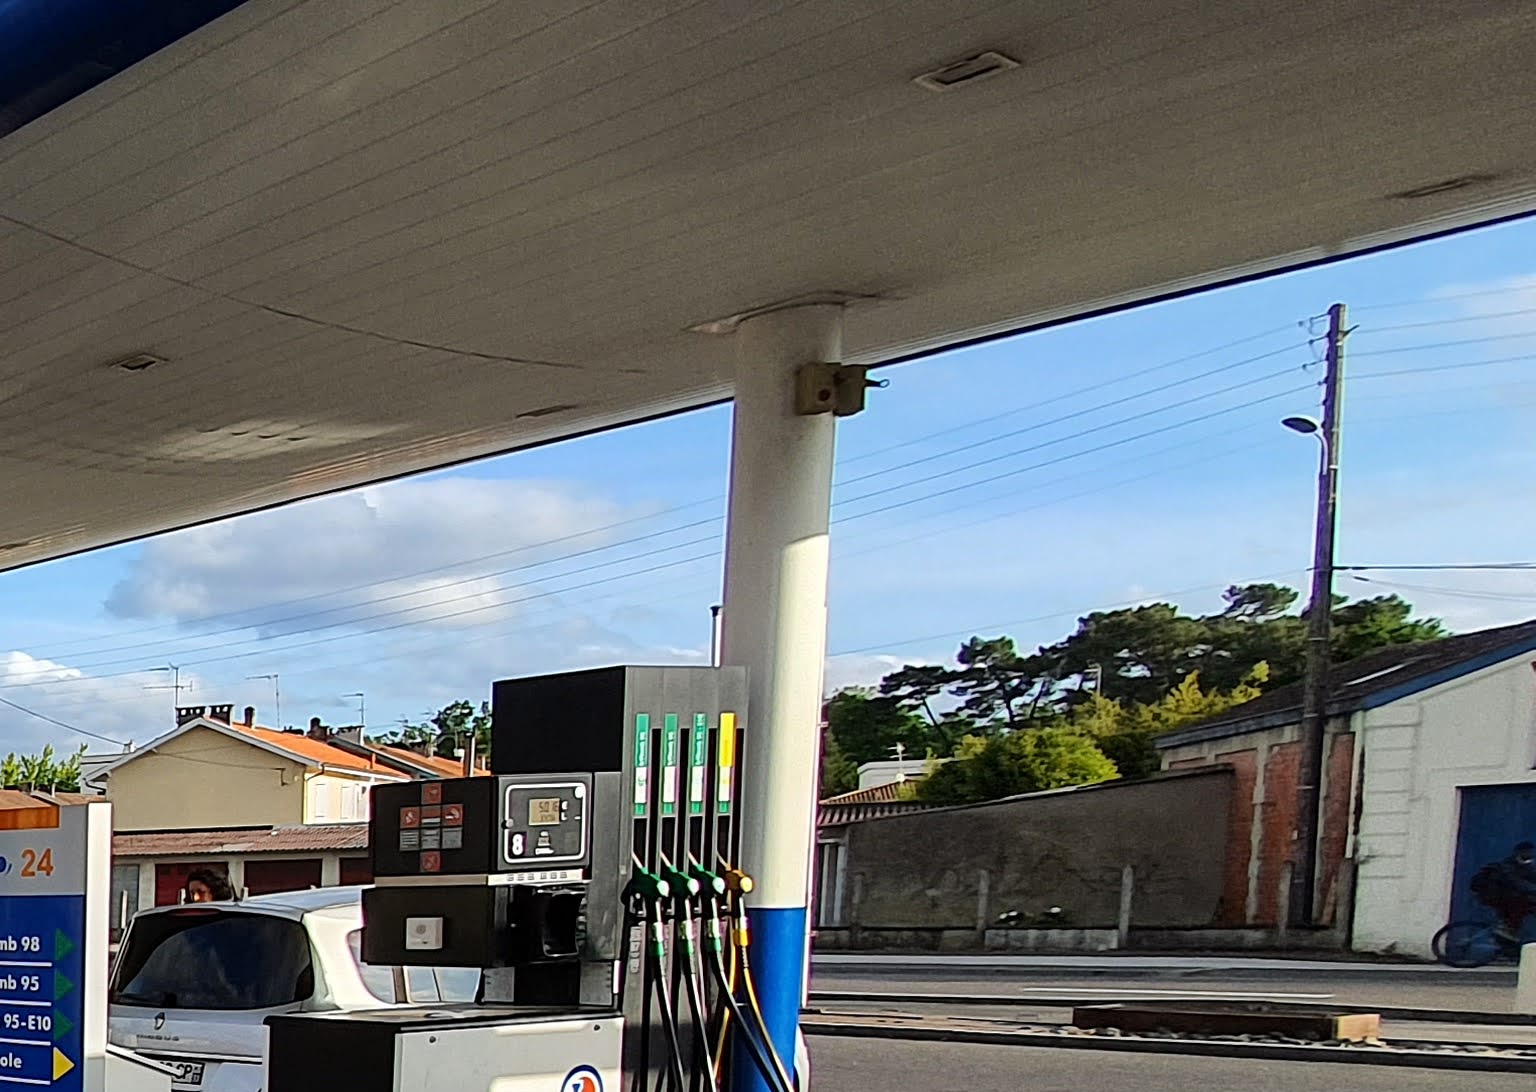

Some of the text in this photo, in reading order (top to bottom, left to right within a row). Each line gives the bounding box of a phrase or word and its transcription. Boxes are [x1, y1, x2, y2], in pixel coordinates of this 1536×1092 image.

[511, 833, 524, 856] 8
[20, 848, 55, 877] 24
[21, 936, 40, 952] 98
[20, 975, 40, 991] 95
[3, 1013, 52, 1031] 95-E10
